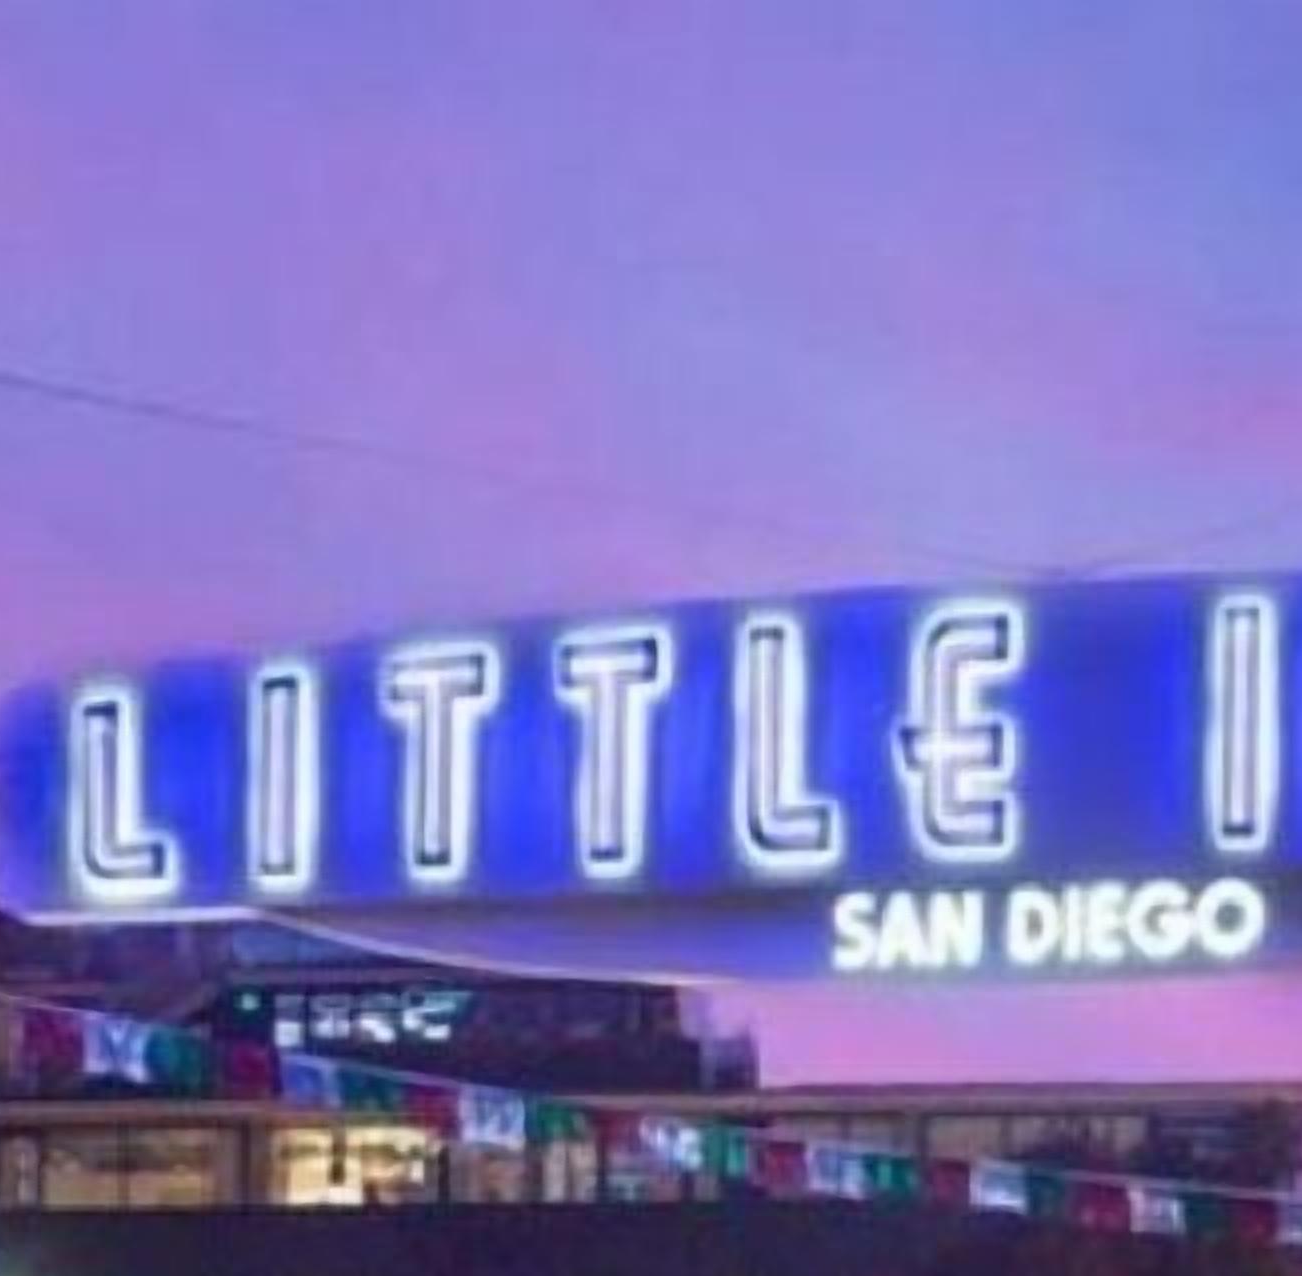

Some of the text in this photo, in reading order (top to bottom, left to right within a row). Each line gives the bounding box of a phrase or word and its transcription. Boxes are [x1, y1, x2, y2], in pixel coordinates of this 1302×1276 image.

[71, 596, 1021, 898] LITTLE
[832, 877, 1266, 970] SAN DIEGO
